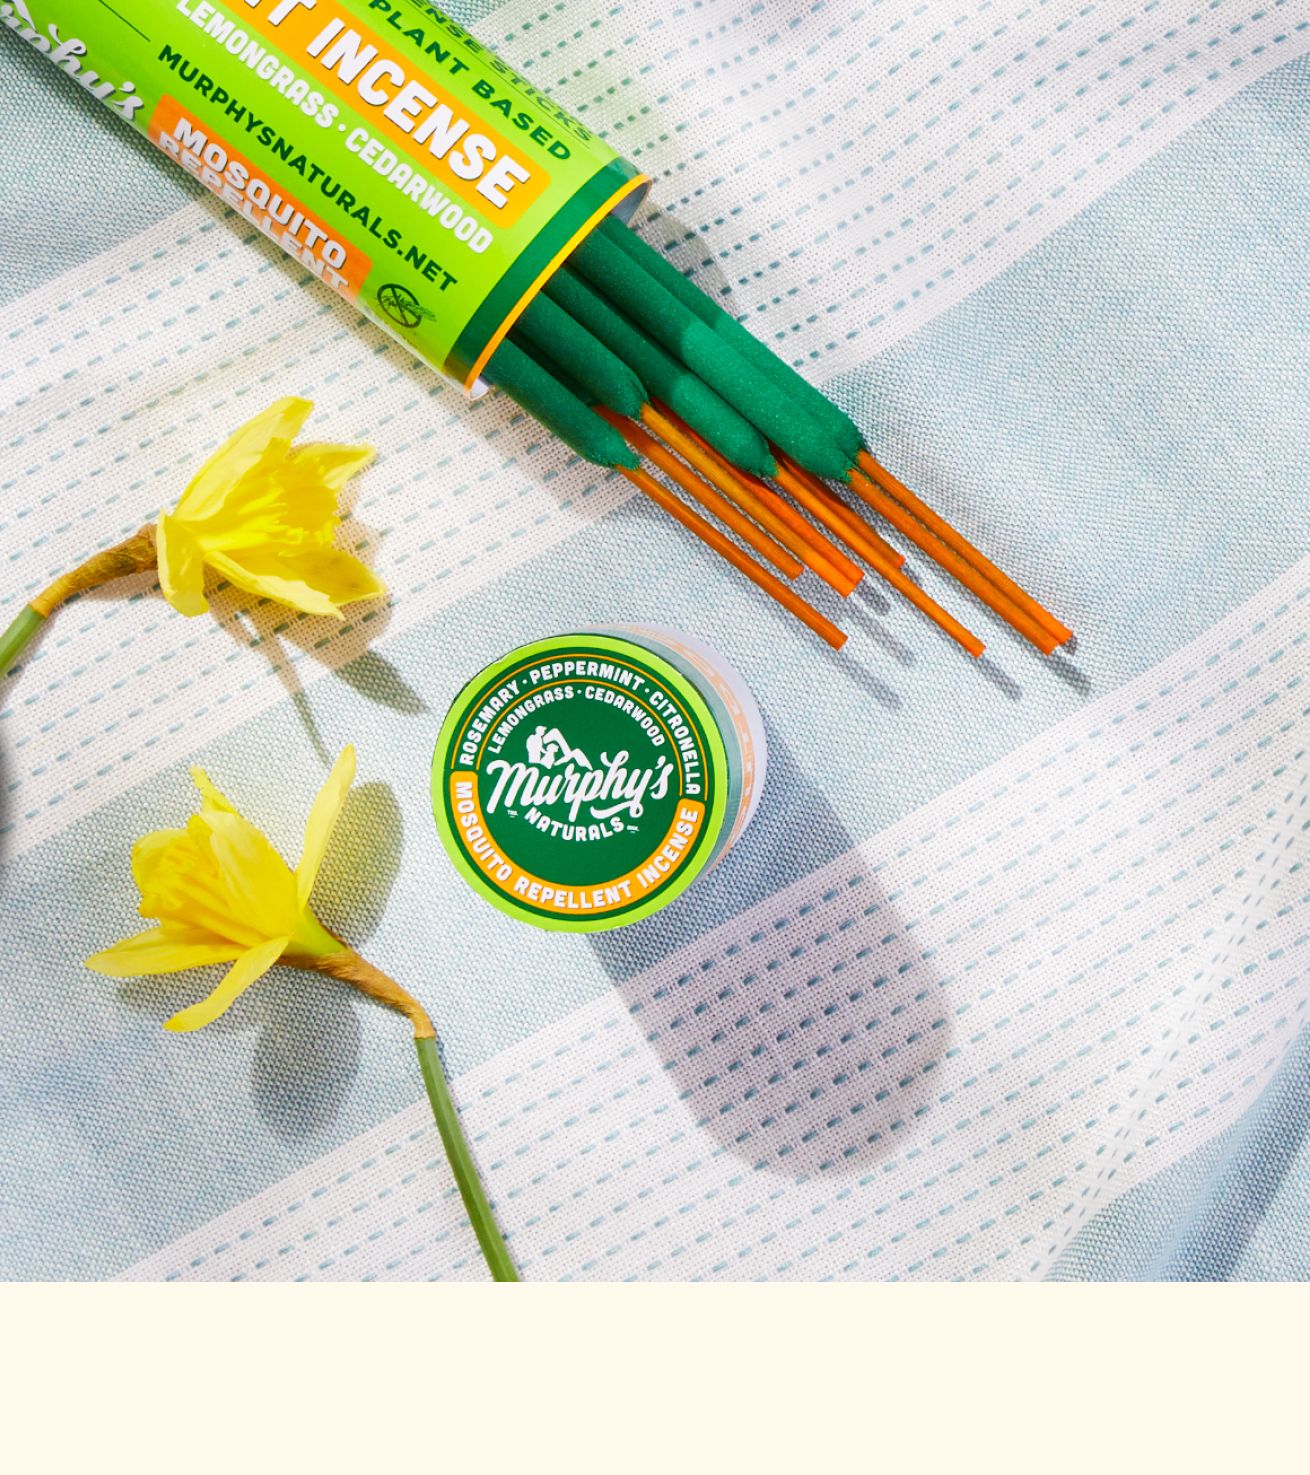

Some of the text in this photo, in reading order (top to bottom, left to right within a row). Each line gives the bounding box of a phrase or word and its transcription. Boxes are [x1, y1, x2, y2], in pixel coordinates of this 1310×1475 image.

[156, 44, 458, 295] MURPHYSNATURALS.NET
[304, 13, 531, 212] INCENSE
[470, 76, 573, 164] BASED
[168, 116, 353, 271] MOSQUITO
[342, 124, 496, 256] CEDARWOOD
[460, 661, 701, 795] ROSEMARY PEPPERMINT CITRONELLA
[487, 686, 665, 754] LEMONGRASS CEDARWOOD
[455, 781, 699, 909] MOSQUITO REPELLENT INCENSE
[486, 750, 674, 822] Murphy's
[524, 807, 625, 841] NATURALS
